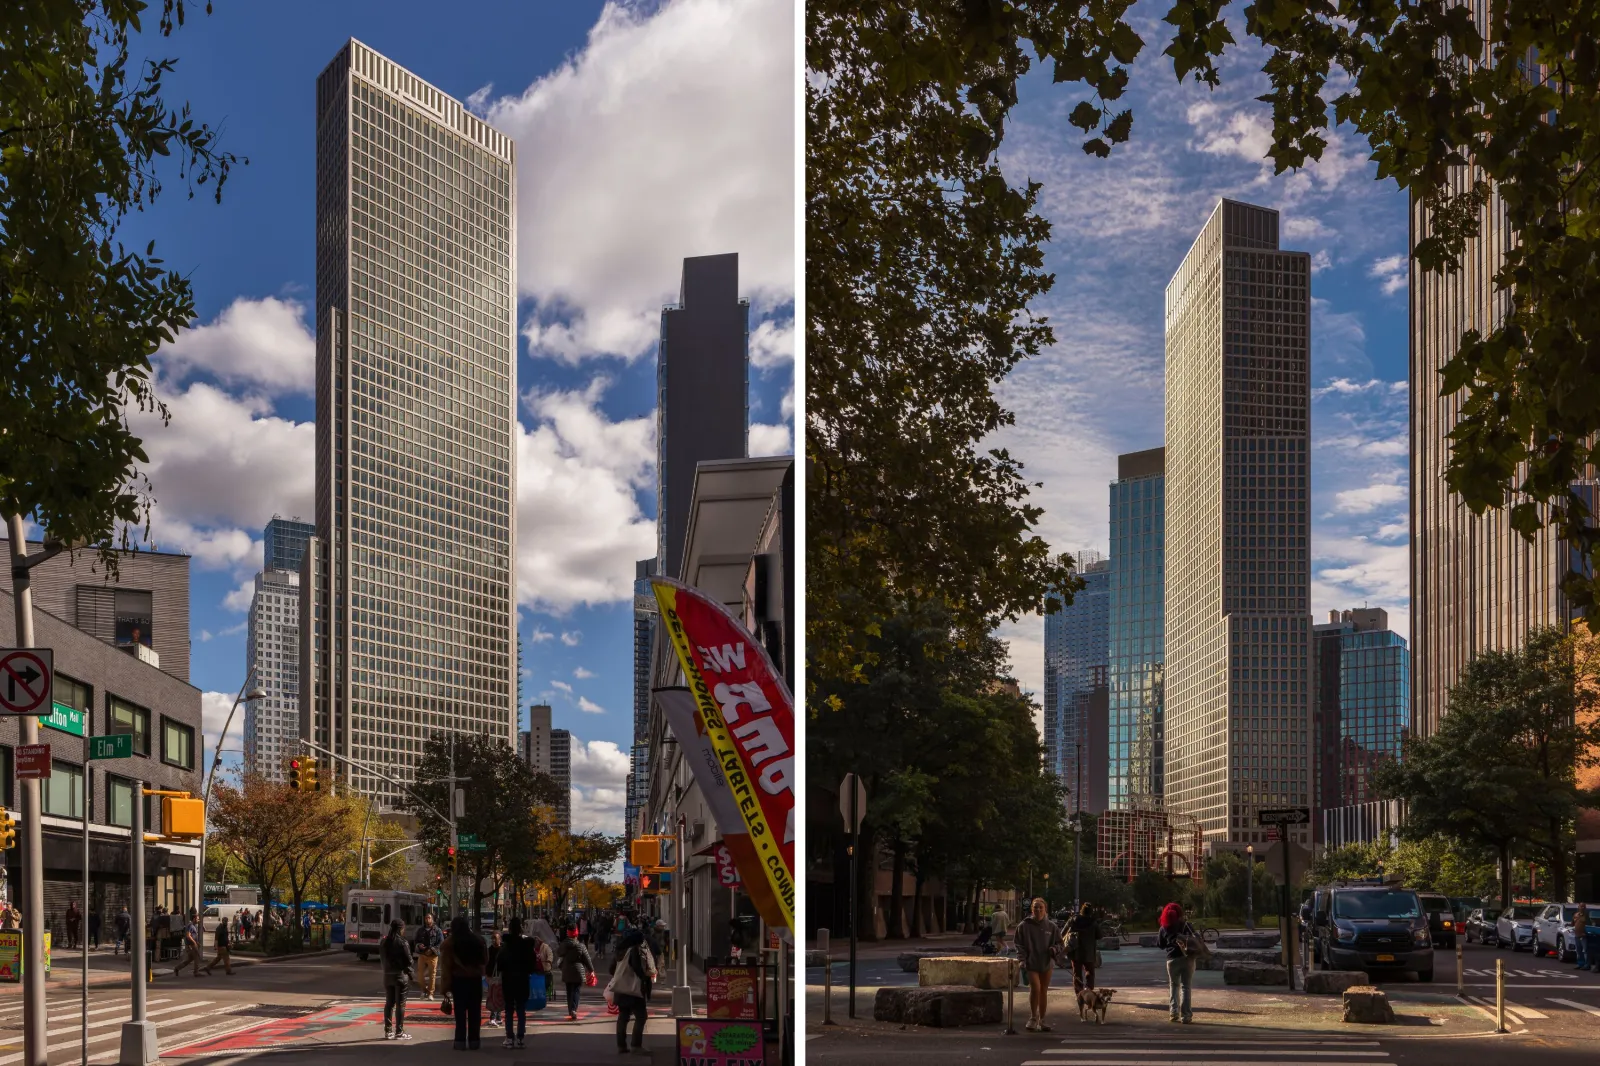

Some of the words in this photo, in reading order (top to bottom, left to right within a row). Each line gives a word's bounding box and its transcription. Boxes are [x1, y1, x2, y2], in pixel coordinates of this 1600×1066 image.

[69, 710, 80, 723] Mall
[22, 747, 45, 755] STANDING
[97, 740, 114, 757] Elm
[117, 737, 123, 748] Pl
[702, 748, 724, 787] mobile
[205, 884, 225, 892] OWER
[1463, 968, 1579, 978] STOP
